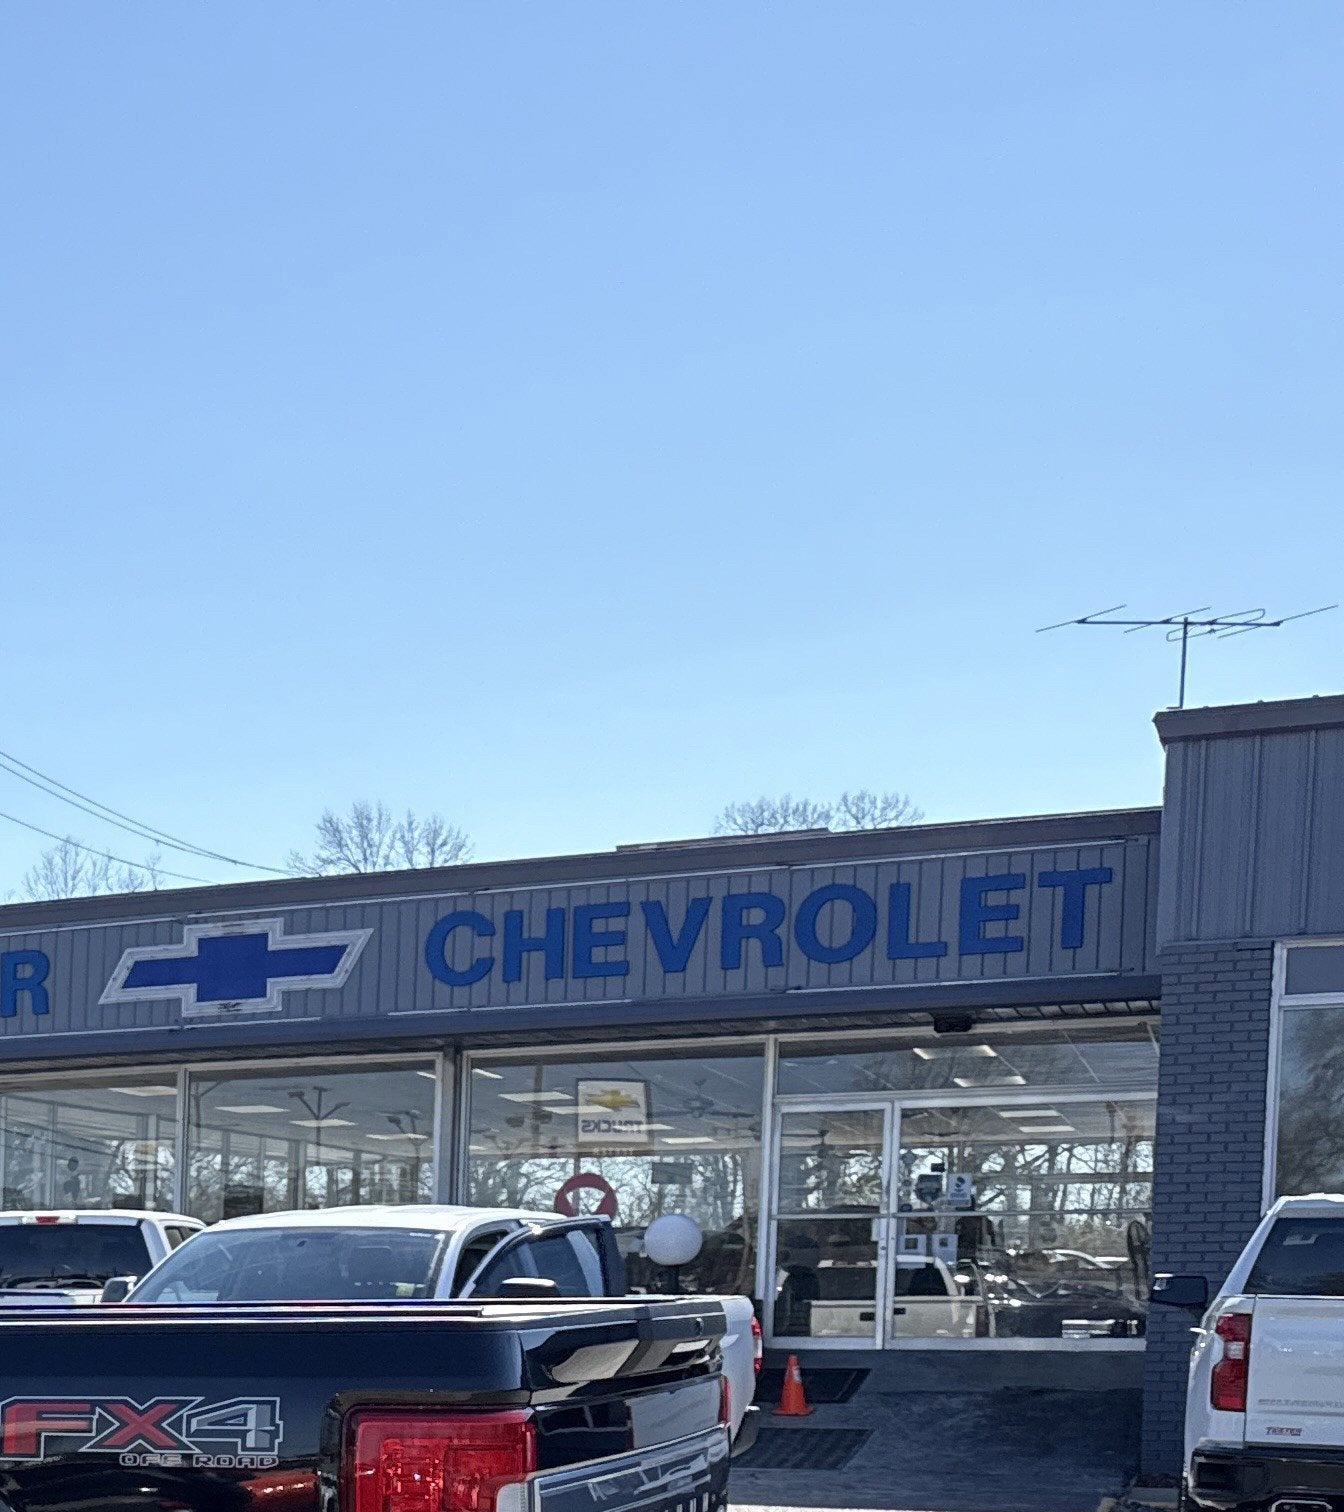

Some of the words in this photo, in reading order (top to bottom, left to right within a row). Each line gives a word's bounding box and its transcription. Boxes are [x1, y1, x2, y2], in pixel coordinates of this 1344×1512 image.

[423, 866, 1114, 988] CHEVROLET
[119, 1453, 182, 1467] OFF
[192, 1453, 279, 1469] ROAD
